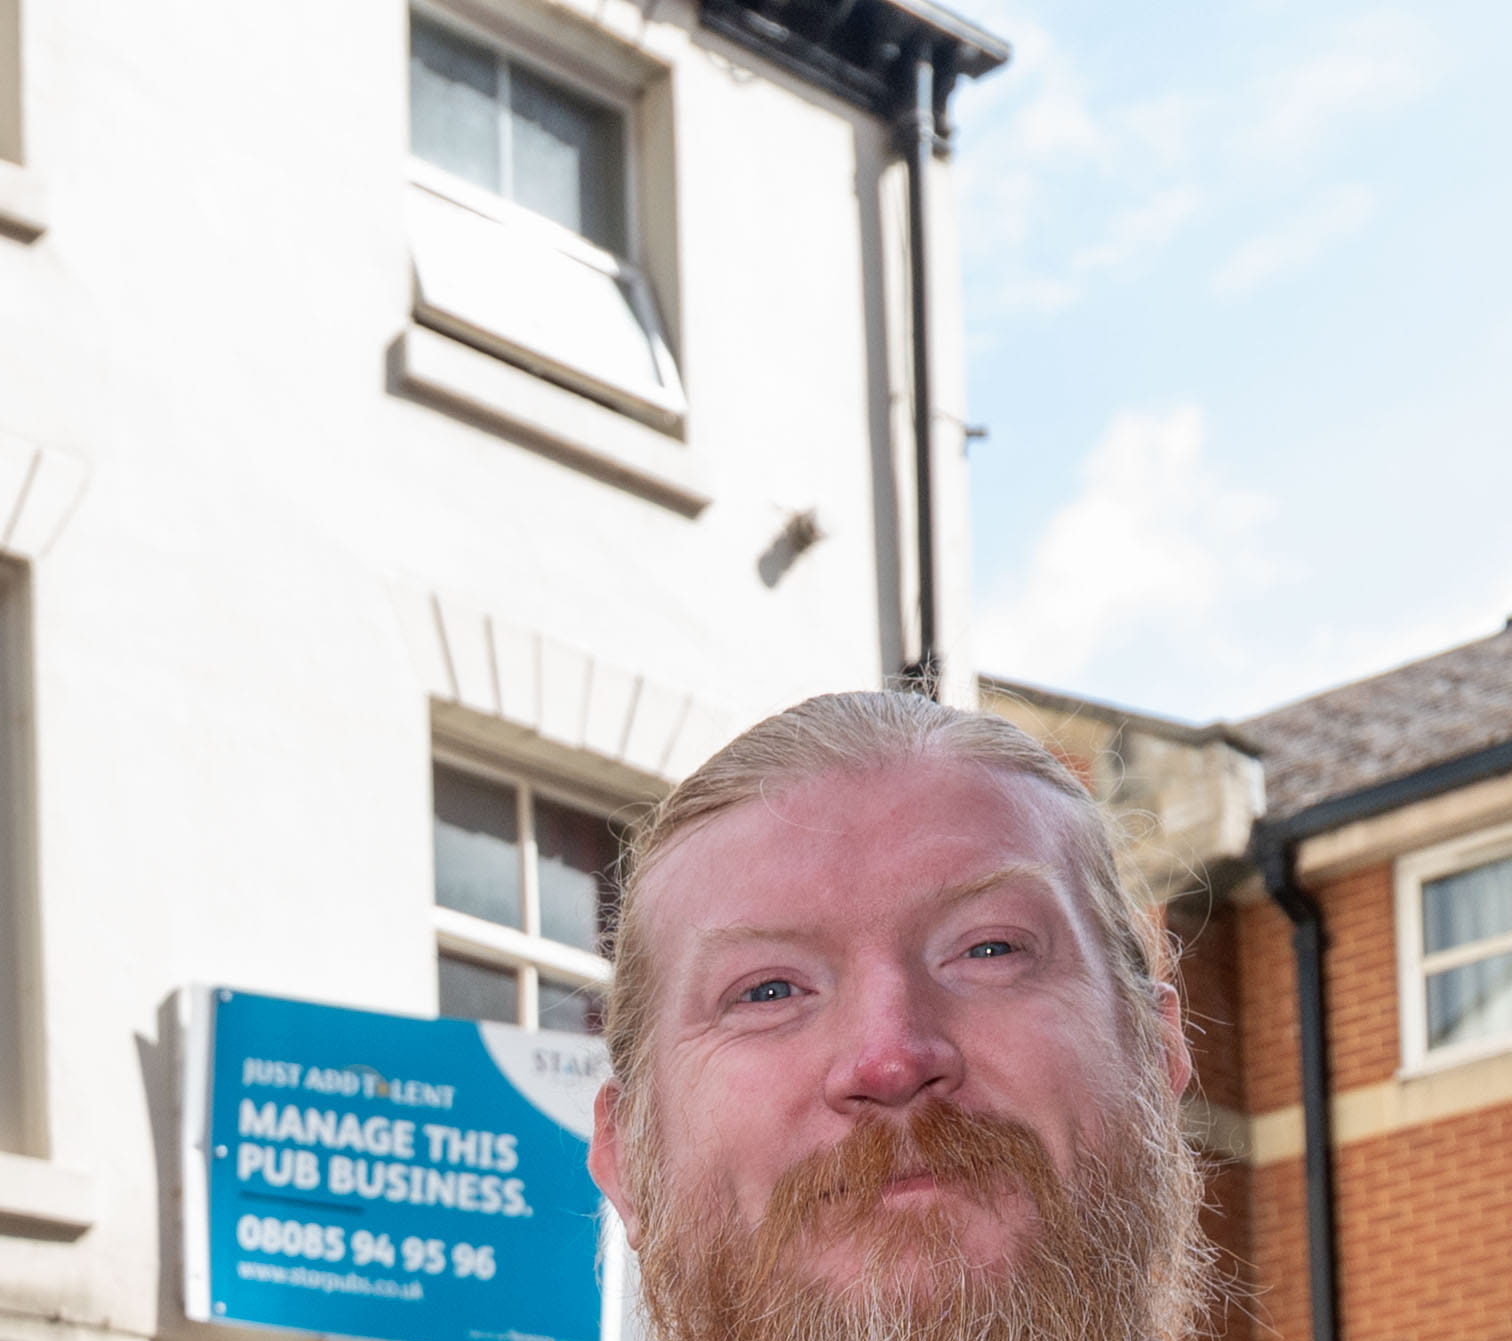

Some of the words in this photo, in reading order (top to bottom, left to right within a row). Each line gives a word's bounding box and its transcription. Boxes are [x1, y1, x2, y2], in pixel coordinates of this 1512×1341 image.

[242, 1057, 302, 1089] JUST
[304, 1066, 360, 1097] ADD
[238, 1098, 416, 1159] MANAGE
[423, 1123, 518, 1173] THIS
[237, 1142, 320, 1190] PUB
[328, 1154, 534, 1218] BUSINESS.
[236, 1213, 346, 1263] 08085
[350, 1229, 396, 1268] 94
[401, 1237, 447, 1276] 95
[451, 1242, 497, 1281] 96
